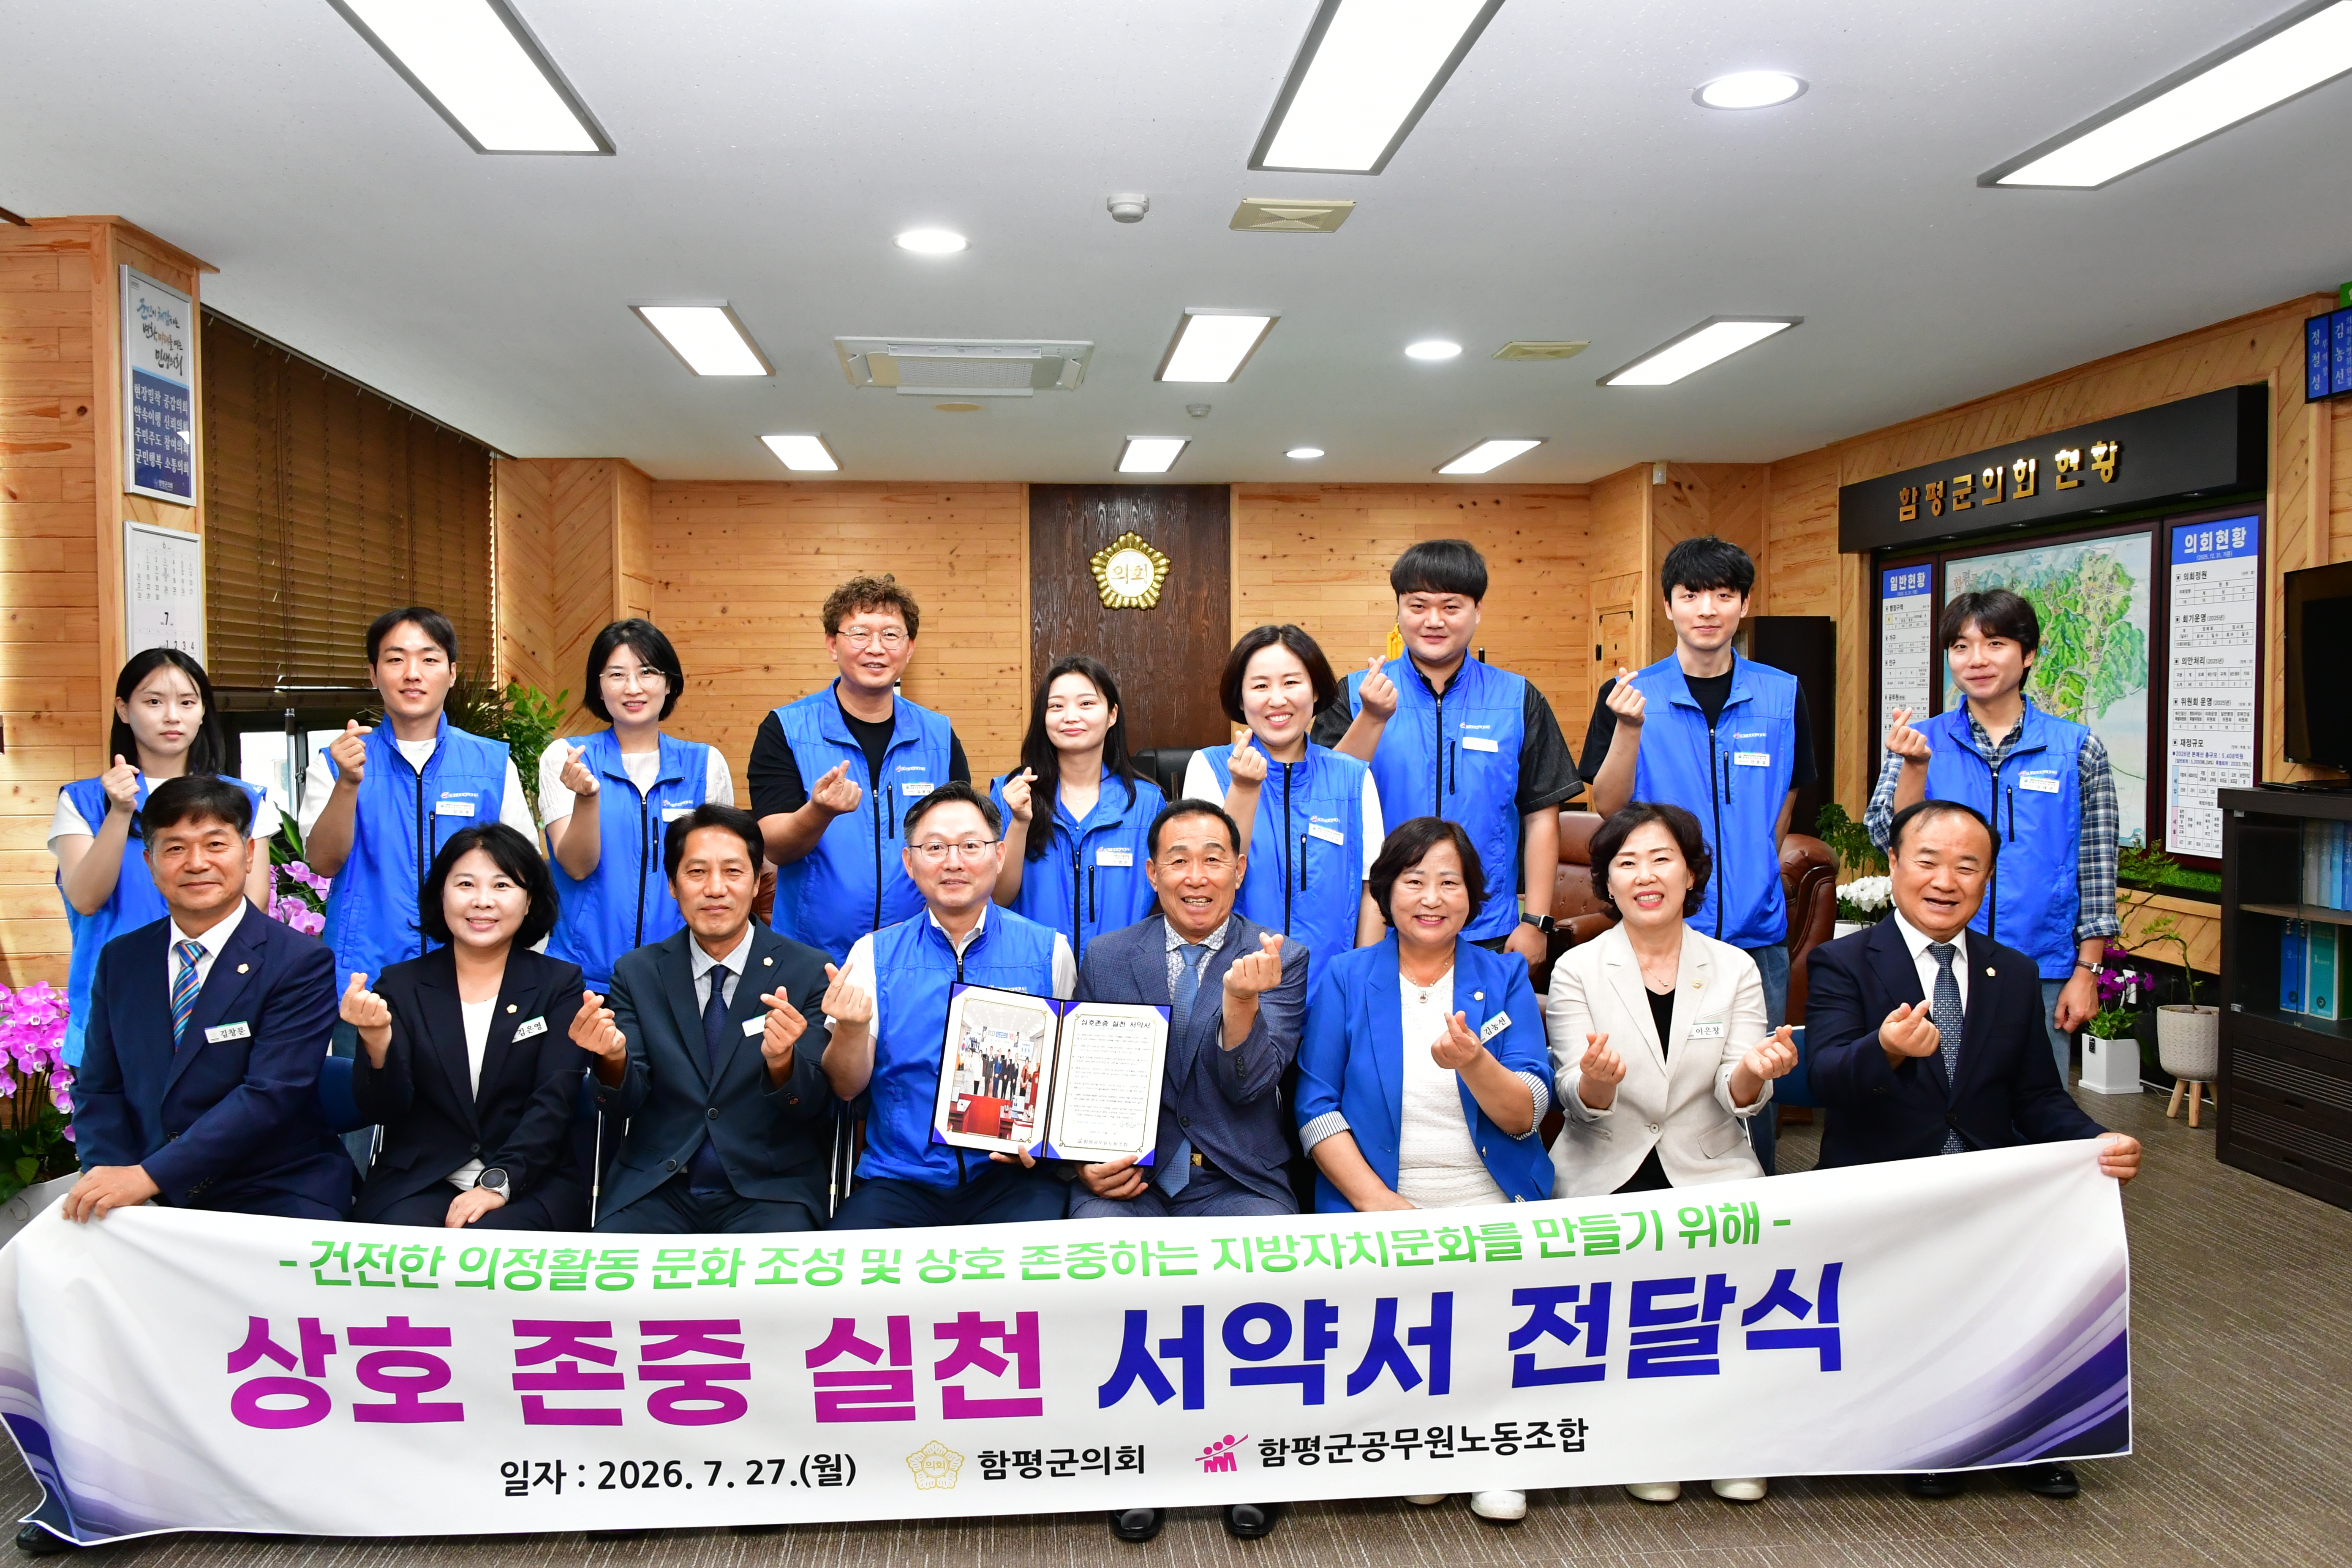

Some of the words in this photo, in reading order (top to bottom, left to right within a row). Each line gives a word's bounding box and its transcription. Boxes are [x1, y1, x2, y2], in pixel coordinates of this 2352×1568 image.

[155, 348, 183, 376] 민생의회
[2335, 322, 2344, 384] 김농선
[134, 384, 161, 406] 현장밀착
[163, 394, 188, 415] 공감의회
[134, 405, 161, 427] 약속이행
[164, 414, 188, 432] 신뢰의회
[134, 427, 162, 446] 주민주도
[164, 435, 189, 456] 참여의회
[135, 449, 162, 469] 군민행복
[164, 457, 189, 476] 소통의회
[1899, 458, 2035, 522] 함평군의회
[2055, 441, 2118, 490] 현황
[2184, 527, 2247, 554] 의회현황
[1111, 564, 1147, 584] 의회
[1890, 572, 1925, 591] 일반현황
[2183, 570, 2207, 581] 의회정원
[164, 612, 169, 626] 7
[2182, 613, 2206, 623] 회기운영
[174, 640, 178, 650] 2
[182, 641, 186, 651] 3
[191, 642, 194, 651] 4
[2181, 656, 2205, 665] 의안처리
[2180, 697, 2198, 706] 위원회
[2200, 697, 2212, 706] 운영
[2180, 738, 2204, 747] 재정규모
[220, 1027, 245, 1038] 김창문
[517, 1022, 542, 1037] 김은영
[1081, 1019, 1108, 1027] 상호존중
[1484, 1017, 1507, 1036] 김농선
[310, 1241, 445, 1289] 건전한
[455, 1247, 639, 1291] 의정활동
[652, 1247, 746, 1289] 문화
[755, 1248, 845, 1287] 조성
[861, 1249, 901, 1285] 및
[917, 1247, 1005, 1284] 상호
[1020, 1240, 1198, 1280] 존중하는
[1212, 1222, 1522, 1273] 지방자치문화를
[1533, 1210, 1663, 1258] 만들기
[1678, 1201, 1760, 1249] 위해
[228, 1316, 465, 1429] 상호
[512, 1319, 751, 1426] 존중
[806, 1311, 1043, 1423] 실천
[1099, 1292, 1453, 1410] 서약서
[1509, 1263, 1843, 1388] 전달식
[1258, 1418, 1589, 1468] 함평군공무원노동조합
[925, 1460, 945, 1470] 의회
[977, 1445, 1144, 1481] 함평군의회
[500, 1459, 567, 1497] 일자
[598, 1460, 693, 1490] 2026.
